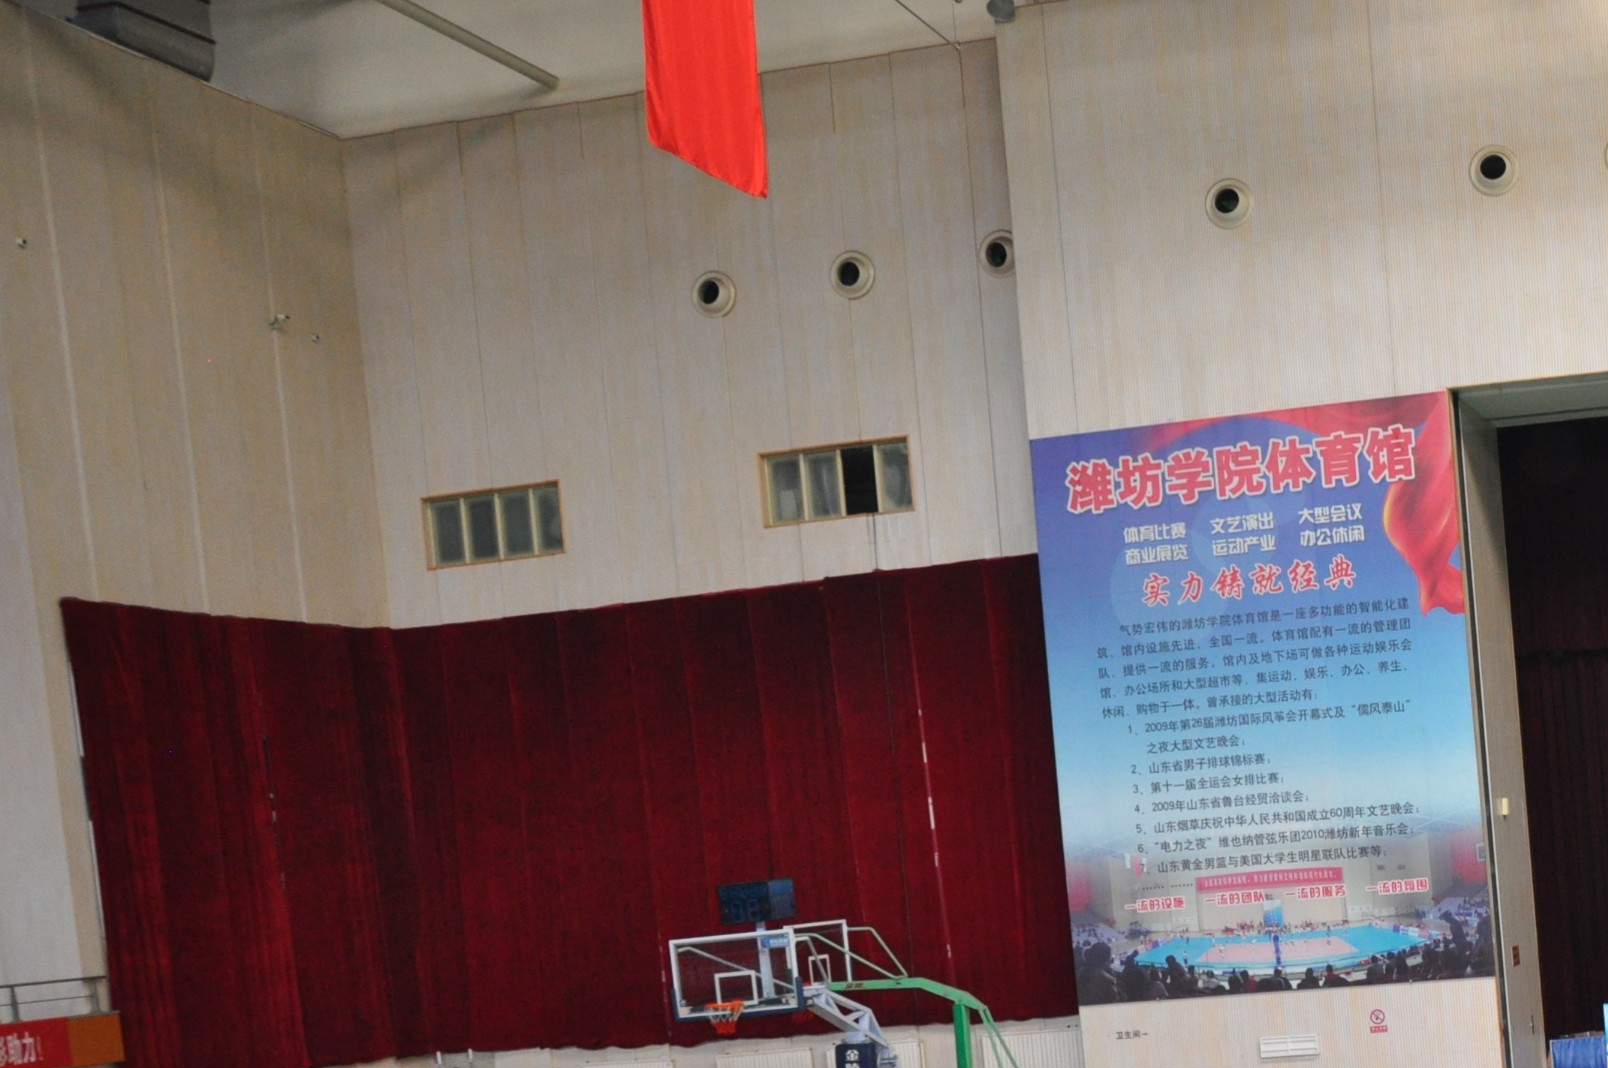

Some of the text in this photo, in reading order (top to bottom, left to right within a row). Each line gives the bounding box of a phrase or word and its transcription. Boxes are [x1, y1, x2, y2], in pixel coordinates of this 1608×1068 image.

[1065, 424, 1417, 514] 潍坊学院体育馆
[1123, 502, 1363, 544] 体育比赛 文艺演出 大型会议
[1124, 524, 1366, 566] 商业展览 运动产业 办公休闲
[1142, 553, 1357, 608] 实力铸就经典
[1119, 597, 1410, 637] 气势宏伟的潍坊学院体育馆是一座多功能的智能化建
